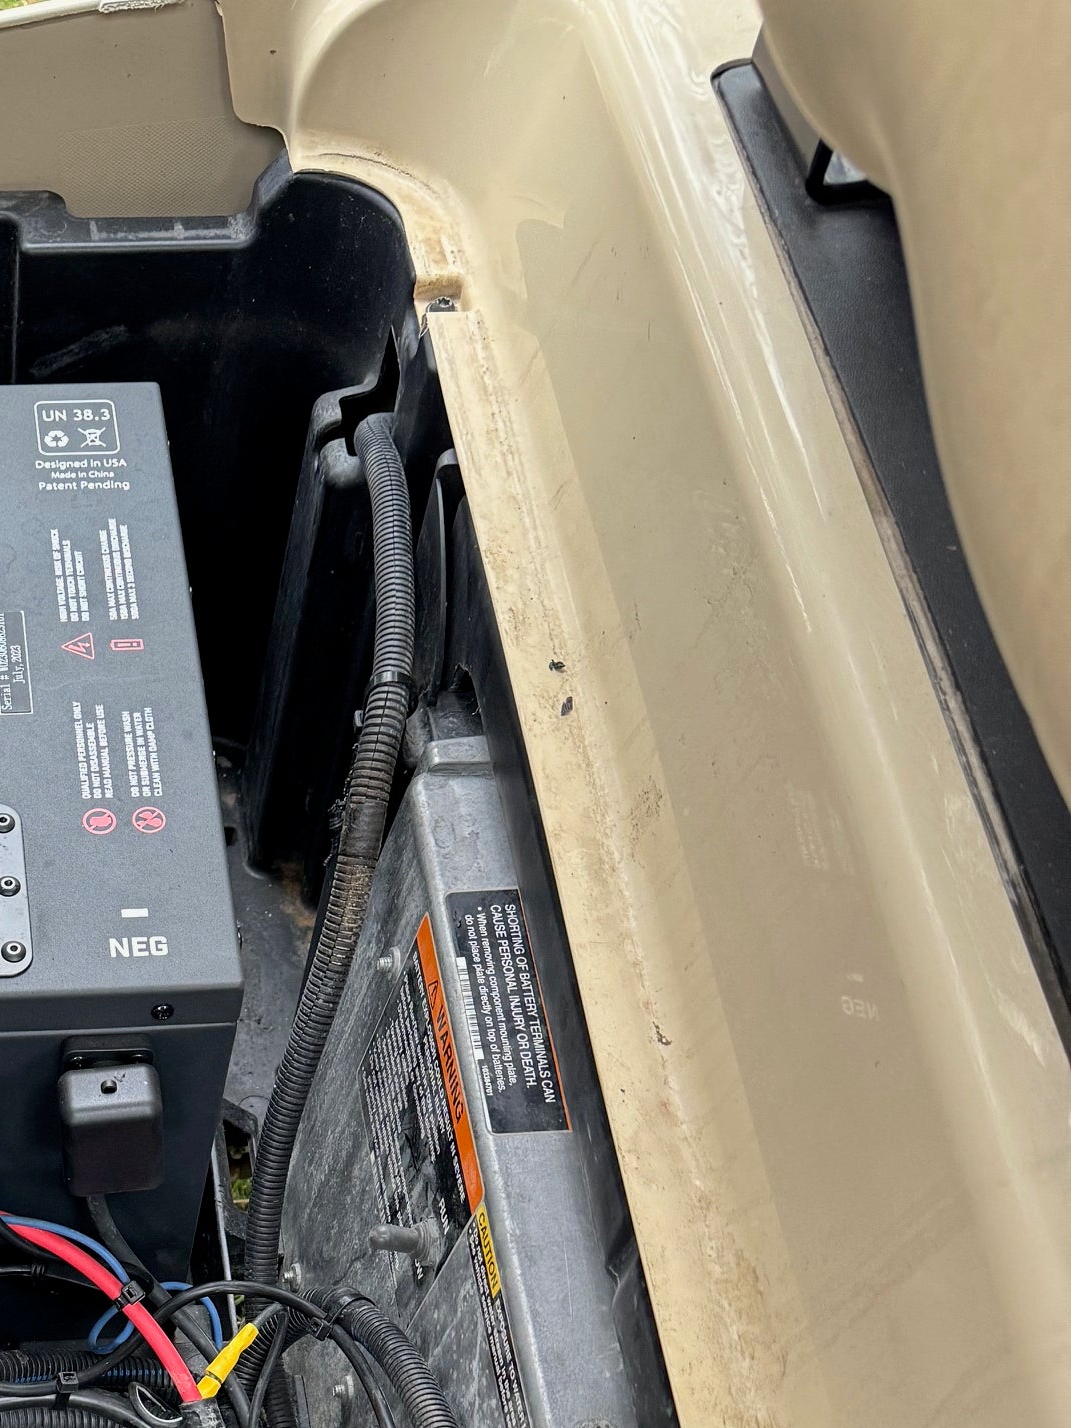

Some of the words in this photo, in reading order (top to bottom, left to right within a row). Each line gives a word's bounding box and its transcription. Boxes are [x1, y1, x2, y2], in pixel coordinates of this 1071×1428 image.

[41, 409, 67, 422] UN
[72, 408, 111, 421] 38.3
[35, 459, 88, 470] Designed
[103, 458, 128, 468] USA
[51, 471, 77, 479] Made
[88, 470, 115, 479] China
[38, 481, 78, 491] Patent
[80, 480, 131, 491] Pending
[9, 645, 22, 662] 2023
[11, 663, 25, 683] July,
[0, 683, 12, 710] Serial
[72, 701, 81, 719] ONLY
[95, 703, 104, 718] USE
[121, 711, 131, 731] WASH
[143, 707, 154, 729] CLOTH
[96, 719, 107, 746] BEFORE
[133, 712, 143, 736] WATER
[74, 719, 86, 761] PERSONNEL
[85, 722, 99, 771] DISASSEMBLE
[123, 732, 136, 769] PRESSURE
[136, 737, 144, 745] IN
[146, 730, 156, 751] DAMP
[99, 747, 111, 777] MANUAL
[137, 746, 149, 785] SUBMERGE
[149, 752, 159, 771] WITH
[78, 762, 91, 798] QUALIFIED
[91, 772, 100, 786] NOT
[103, 778, 113, 797] READ
[128, 770, 138, 785] NOT
[151, 772, 162, 795] CLEAN
[92, 788, 101, 798] DO
[130, 786, 139, 797] DO
[142, 786, 151, 796] OR
[464, 914, 475, 924] do
[475, 912, 489, 936] When
[489, 904, 507, 937] CAUSE
[504, 904, 525, 954] SHORTING
[466, 926, 477, 939] not
[109, 935, 169, 958] NEG
[467, 940, 482, 962] place
[479, 938, 497, 974] removing
[412, 948, 424, 1001] BATTERY
[472, 964, 486, 983] plate
[496, 939, 518, 993] PERSONAL
[515, 956, 529, 971] OF
[476, 985, 492, 1014] directly
[486, 976, 505, 1020] component
[518, 972, 538, 1017] BATTERY
[484, 1016, 492, 1026] on
[508, 995, 526, 1030] INJURY
[421, 994, 436, 1063] EXPLOSION
[484, 1029, 496, 1042] top
[489, 1043, 499, 1052] of
[495, 1022, 514, 1061] mounting
[515, 1033, 530, 1049] OR
[528, 1018, 552, 1078] TERMINALS
[435, 1001, 463, 1128] WARNING
[491, 1054, 508, 1092] batteries.
[503, 1062, 519, 1086] plate,
[519, 1051, 538, 1088] DEATH.
[422, 1032, 436, 1097] PERSONAL
[434, 1091, 444, 1137] INJURY
[433, 1056, 444, 1102] COULD
[540, 1080, 556, 1103] CAN
[441, 1095, 453, 1145] RESULT
[449, 1138, 456, 1158] IN
[452, 1151, 465, 1206] SEVERE
[438, 1194, 449, 1237] RUN
[472, 1227, 479, 1245] Do
[475, 1244, 483, 1264] not
[476, 1211, 500, 1290] CAUTION
[479, 1263, 490, 1295] direct
[485, 1295, 496, 1327] water
[472, 1254, 485, 1295] vehicle
[480, 1292, 493, 1335] service
[496, 1375, 509, 1414] before
[493, 1297, 513, 1363] EXPOSURE
[492, 1325, 504, 1366] stream
[500, 1365, 507, 1380] in
[507, 1360, 516, 1381] TO
[503, 1378, 511, 1400] the
[510, 1378, 525, 1424] WATER
